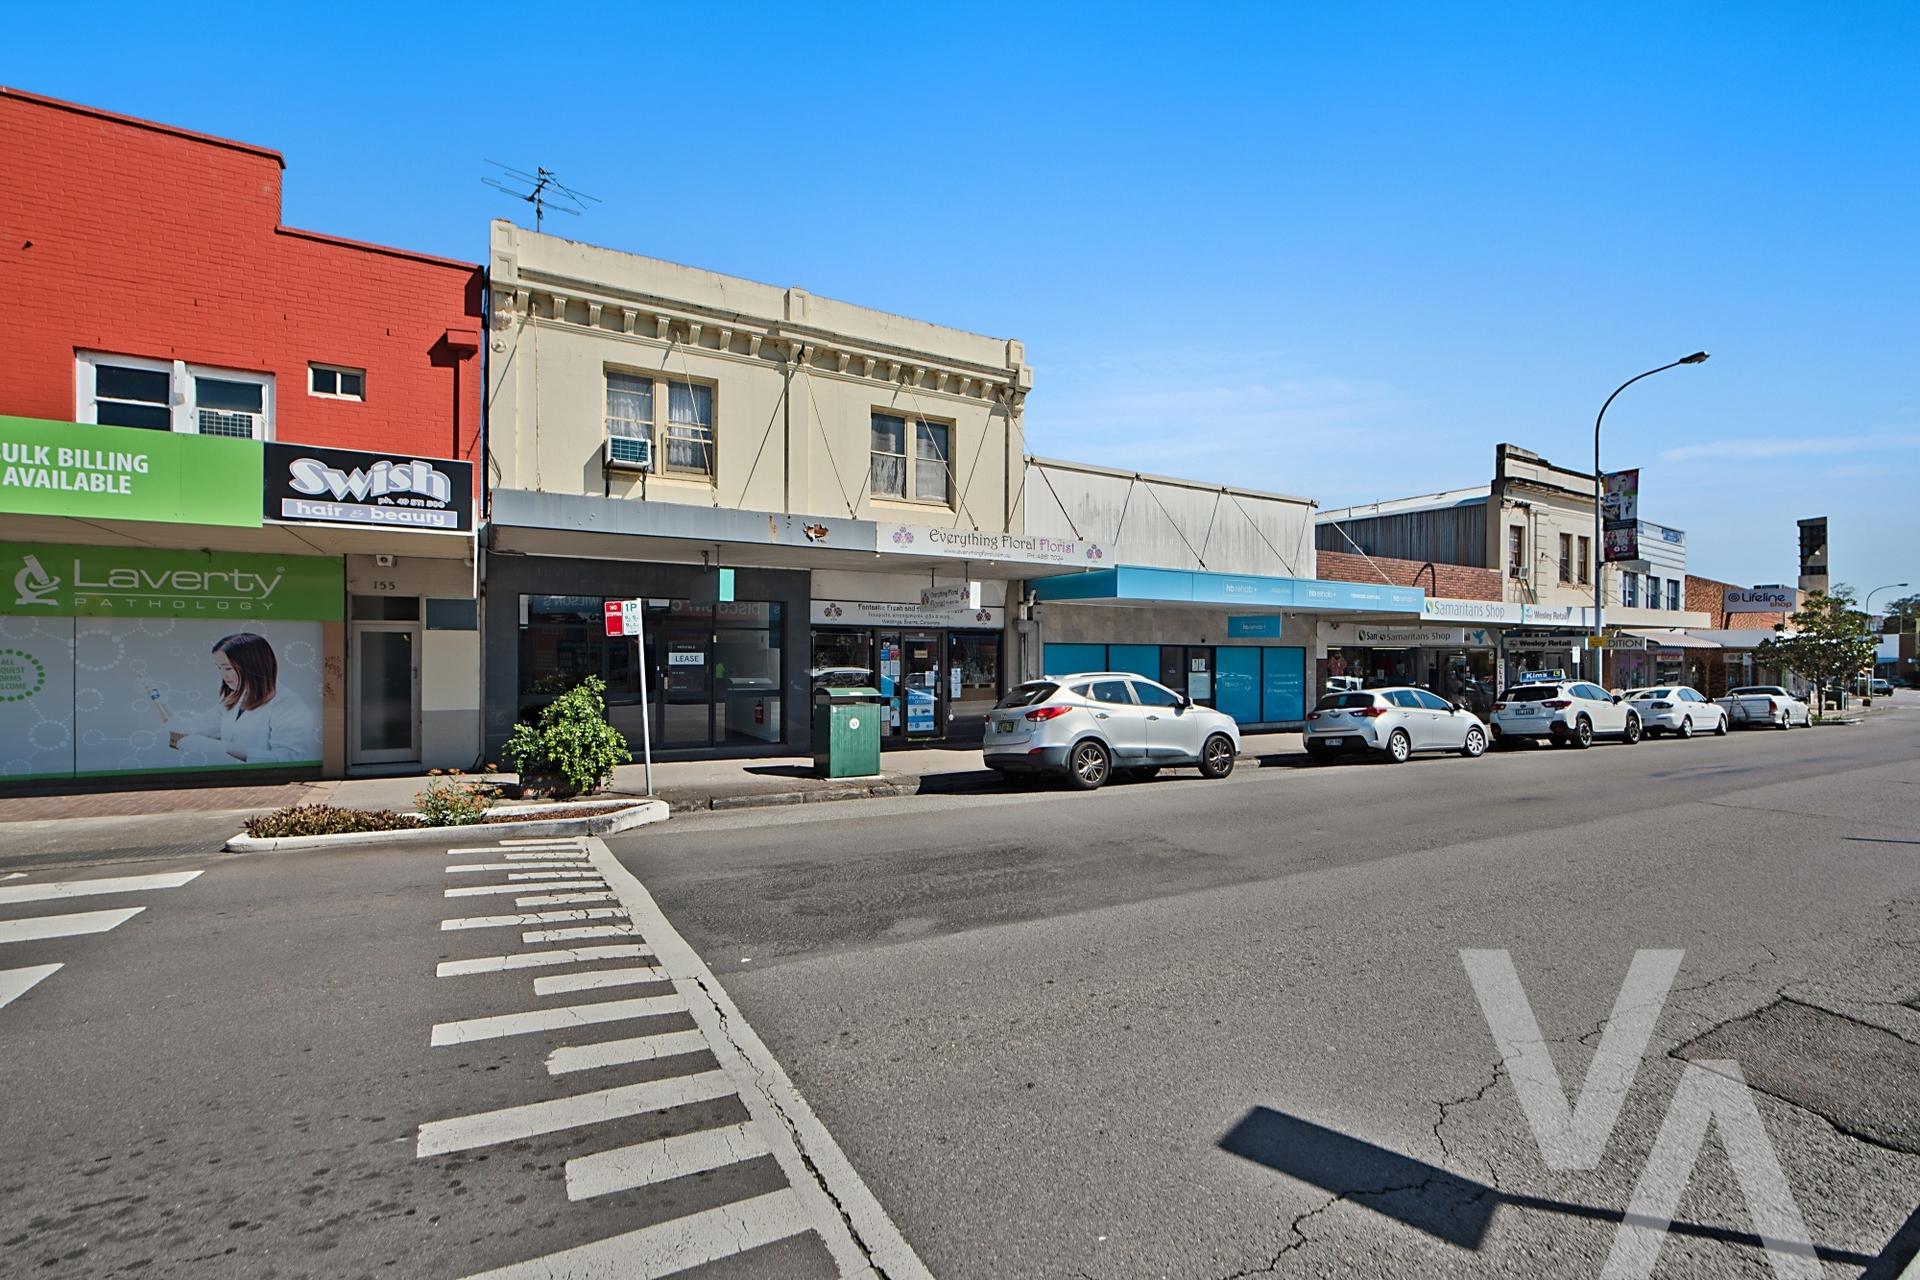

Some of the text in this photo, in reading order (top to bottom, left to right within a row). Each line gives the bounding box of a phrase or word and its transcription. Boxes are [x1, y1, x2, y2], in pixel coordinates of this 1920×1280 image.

[0, 442, 149, 474] ULK BILLING
[2, 466, 132, 494] AVAILABLE
[289, 458, 451, 502] Swish
[297, 501, 445, 526] hair & beauty
[929, 529, 1075, 553] Everything Floral Florist
[74, 559, 283, 599] Laverty
[373, 581, 396, 591] 155
[1742, 592, 1785, 603] Lifeline
[74, 598, 274, 610] PATHOLOGY
[625, 603, 637, 612] 1P
[1769, 601, 1792, 609] shop
[1434, 601, 1505, 620] Samaritans Shop
[1534, 610, 1569, 621] Wesley Retail
[1386, 631, 1429, 641] Samaritans
[1431, 631, 1450, 641] Shop
[1519, 639, 1571, 648] Wesley Retail
[1606, 639, 1642, 648] DITION
[676, 655, 699, 663] LEASE
